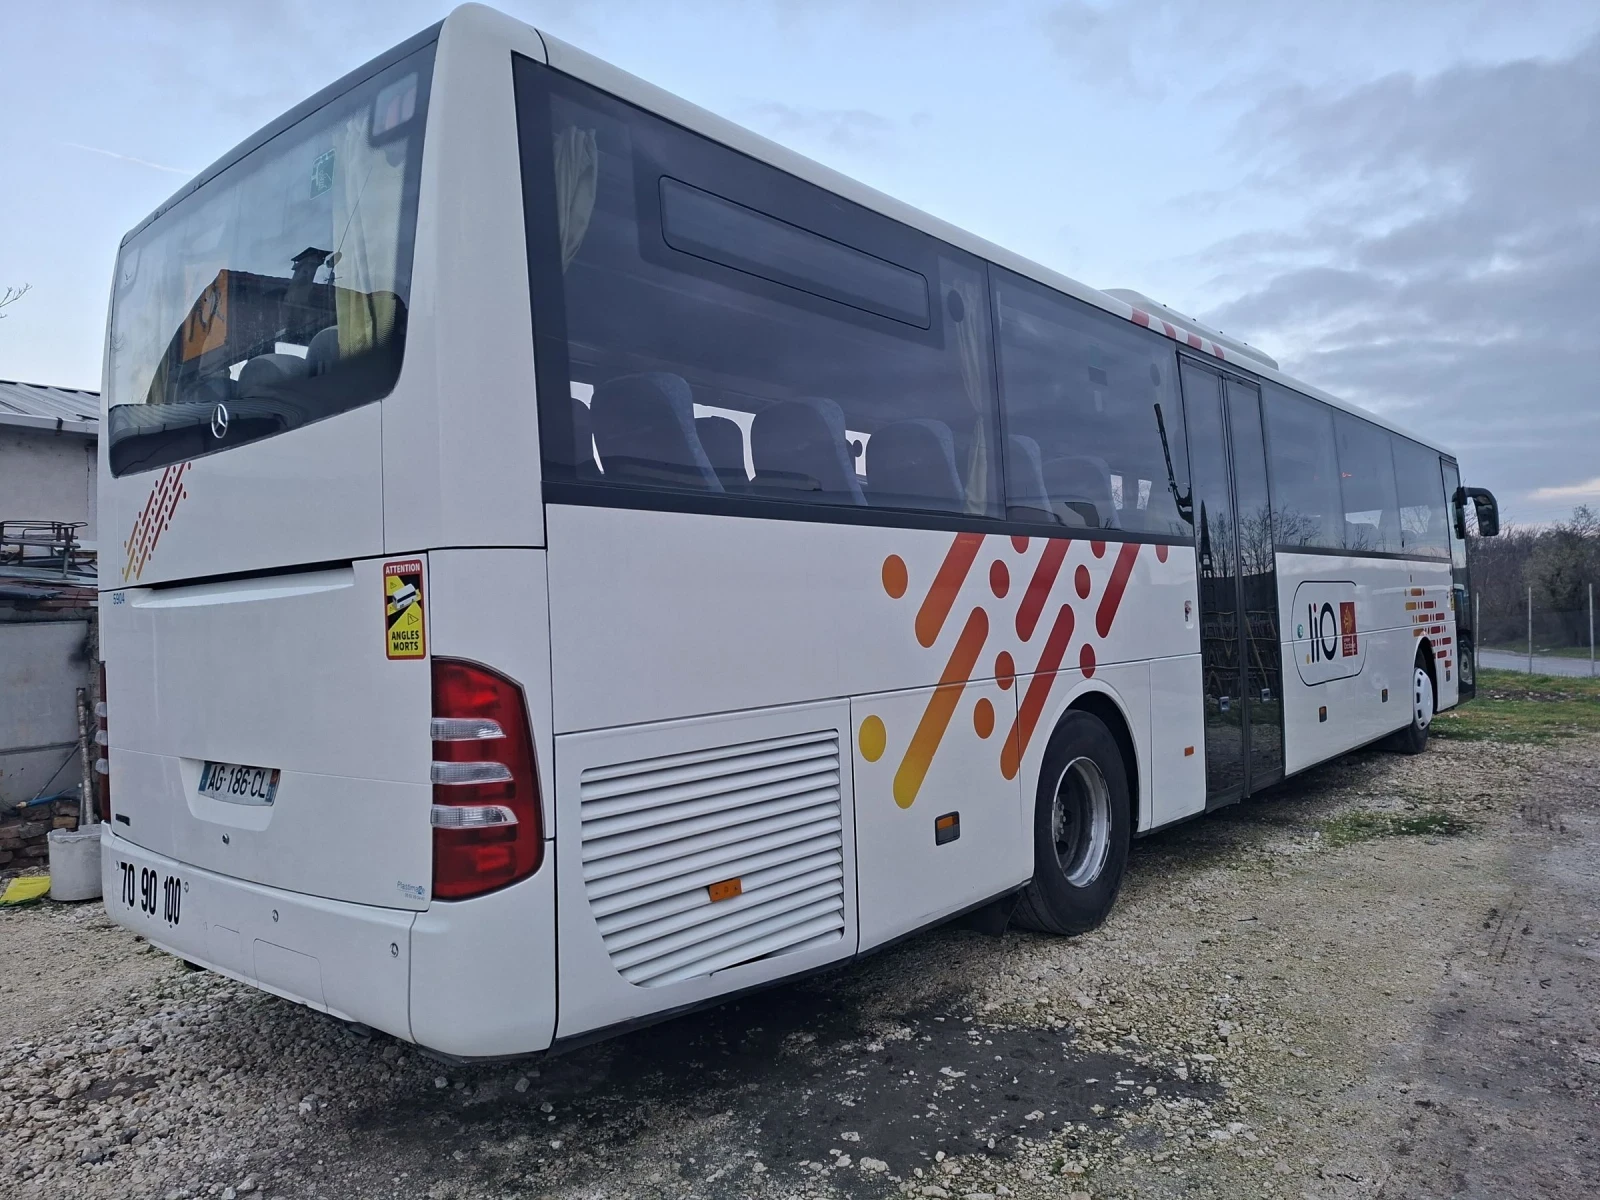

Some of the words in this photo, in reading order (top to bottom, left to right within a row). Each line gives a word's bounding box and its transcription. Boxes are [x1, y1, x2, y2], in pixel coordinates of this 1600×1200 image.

[386, 563, 420, 574] ATTENTION
[391, 630, 420, 641] ANGLES
[393, 641, 419, 651] MORTS
[121, 862, 135, 907] 70
[141, 867, 157, 915] 90
[164, 876, 181, 925] 100
